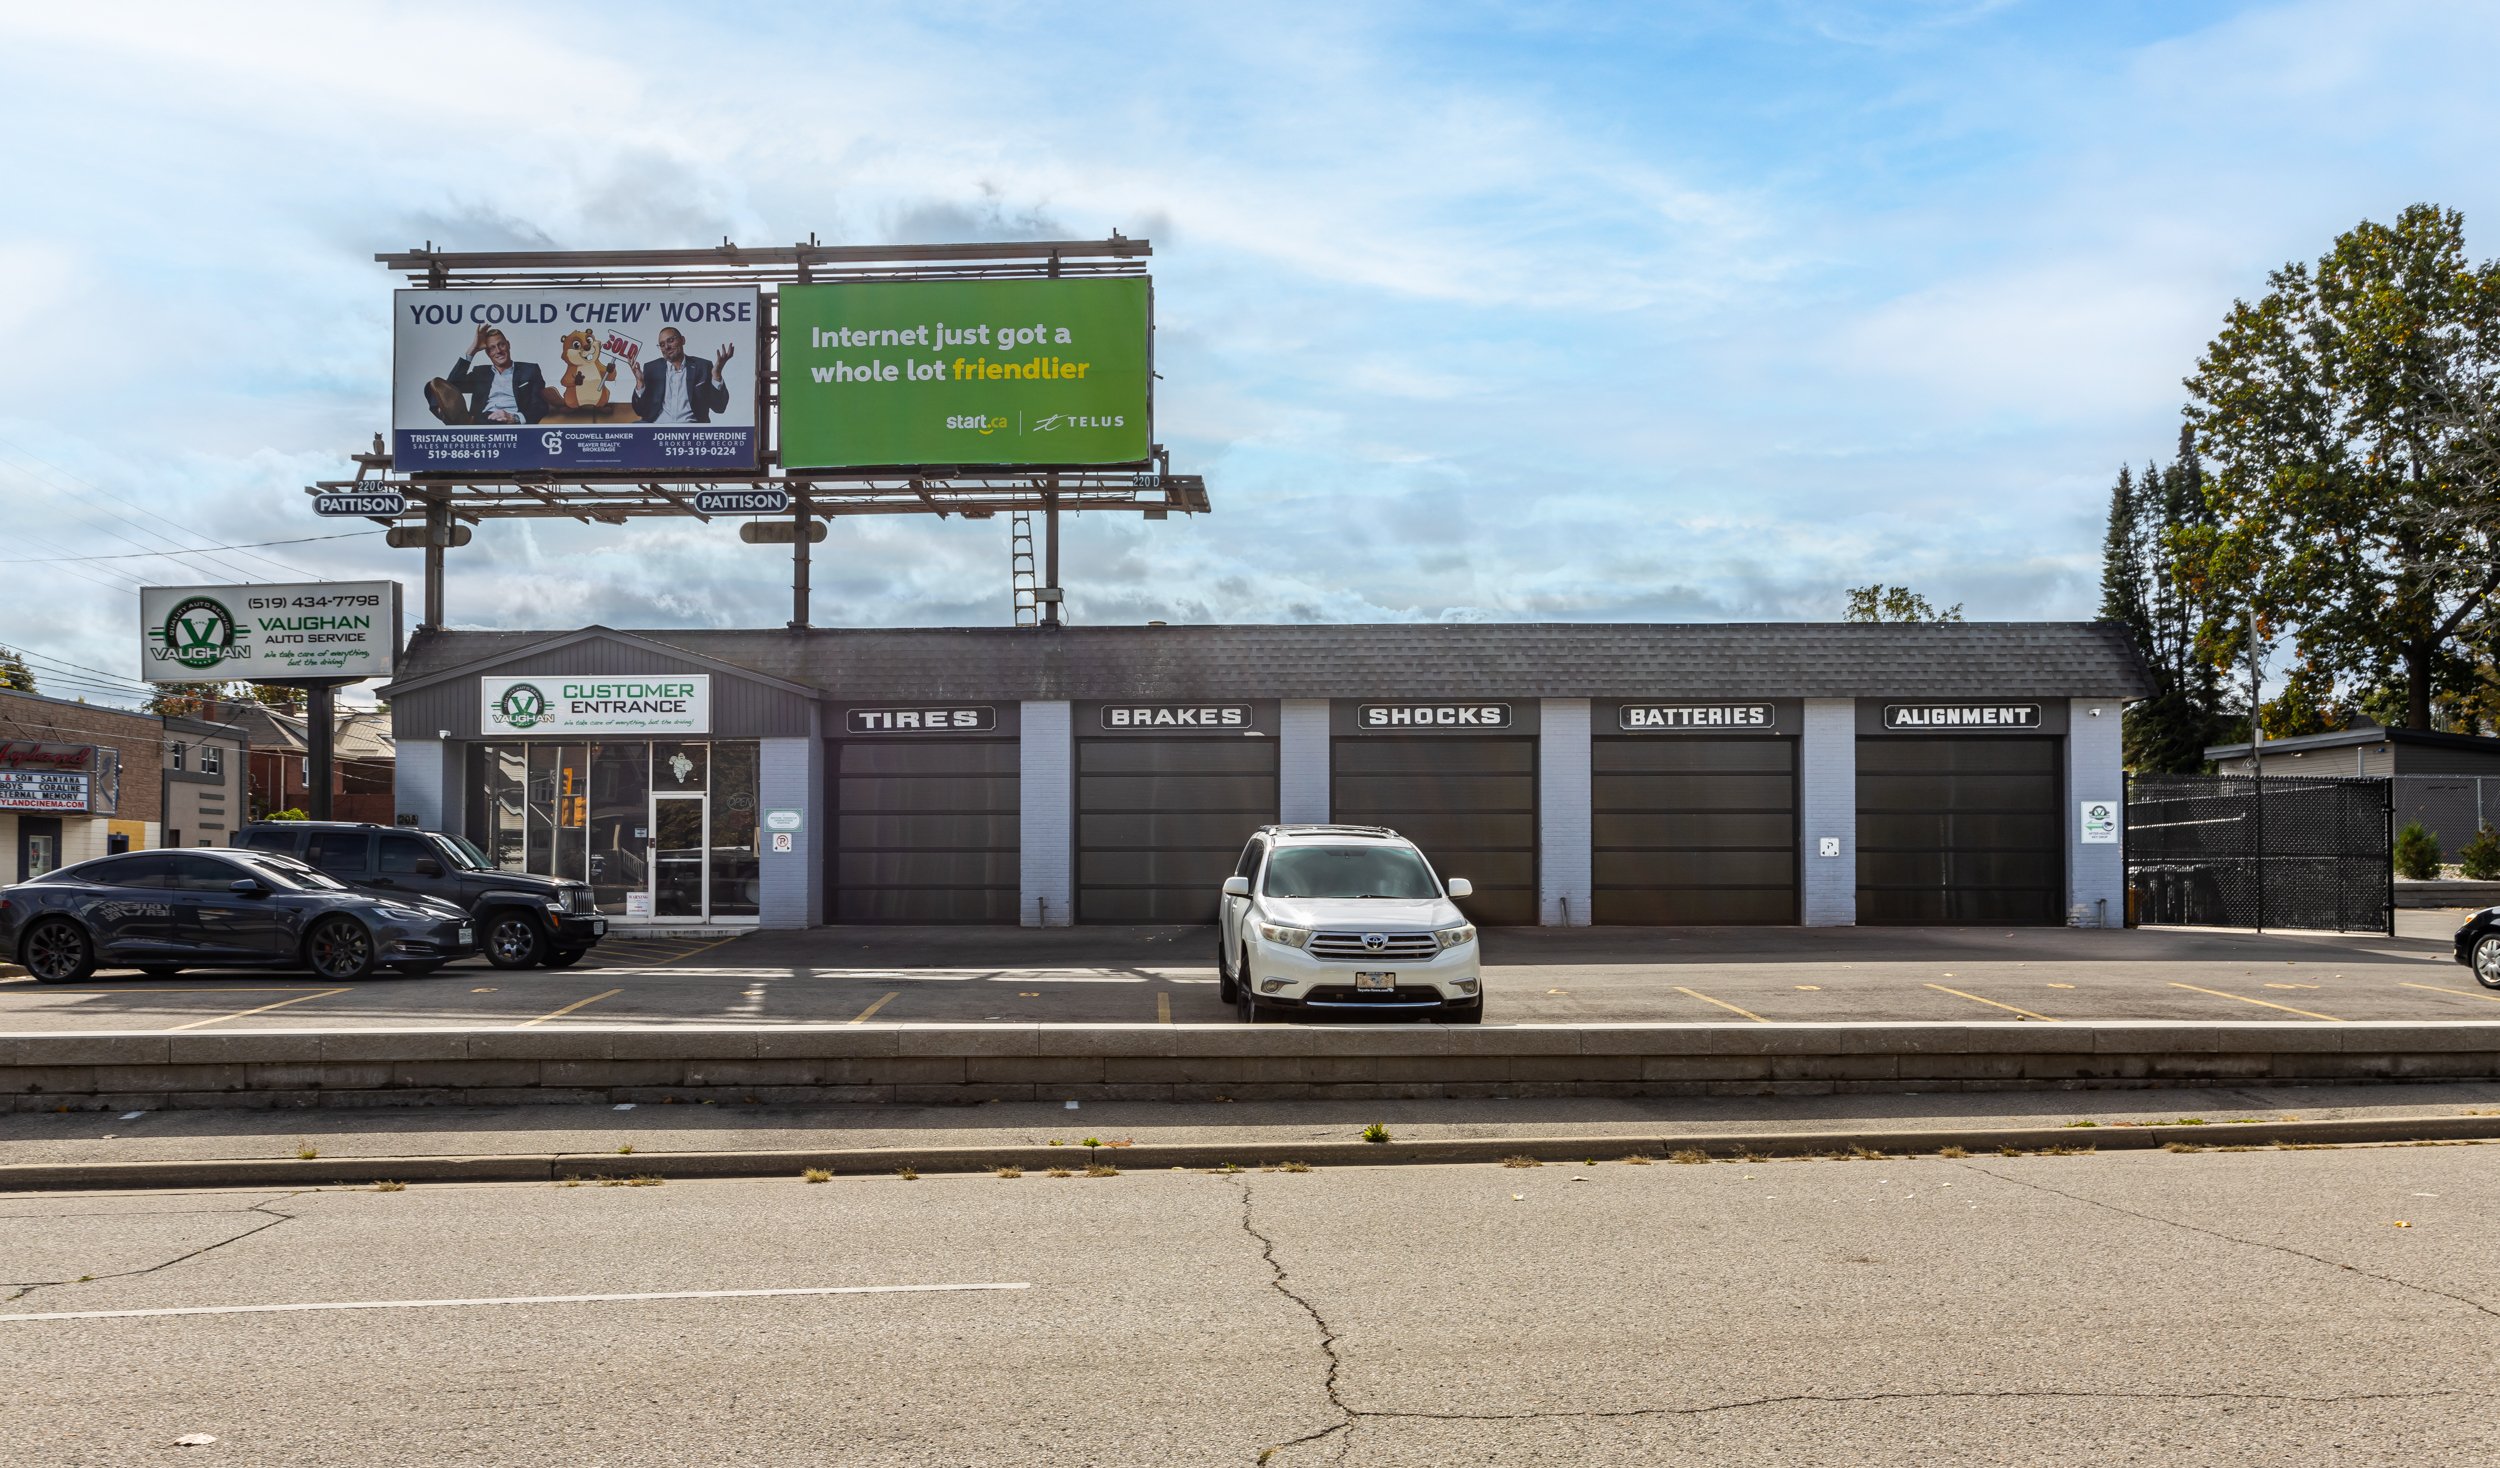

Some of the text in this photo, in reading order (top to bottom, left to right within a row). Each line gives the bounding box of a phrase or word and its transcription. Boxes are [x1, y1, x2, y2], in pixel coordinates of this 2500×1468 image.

[409, 301, 752, 325] YOU COULD 'CHEW' WORSE
[811, 323, 1072, 351] Internet just got a
[603, 334, 639, 360] SOLD
[811, 355, 1090, 383] whole lot friendlier
[946, 414, 1008, 429] start.ca
[1067, 415, 1125, 427] TELUS
[410, 433, 518, 443] TRISTAN SQUIRE-SMITH
[652, 432, 747, 441] JOHNNY HEWERDINE
[427, 449, 500, 459] 519-868-6119
[665, 446, 736, 456] 519-319-0224
[358, 480, 384, 491] 220 C
[1132, 475, 1150, 488] 220
[319, 498, 399, 512] PATTISON
[702, 494, 781, 509] PATTISON
[248, 595, 380, 610] (519) 434-7798
[257, 615, 370, 631] VAUGHAN
[265, 632, 366, 644] AUTO SERVICE
[150, 645, 251, 661] VAUGHAN
[279, 650, 295, 658] take
[317, 649, 330, 657] of
[287, 659, 302, 667] but
[304, 658, 318, 666] the
[563, 683, 695, 699] CUSTOMER
[571, 700, 687, 714] ENTRANCE
[492, 713, 555, 723] VAUGHAN
[859, 710, 978, 729] TIRES
[1111, 708, 1242, 726] BRAKES
[1368, 707, 1502, 725] SHOCKS
[1630, 707, 1765, 726] BATTERIES
[1895, 707, 2032, 725] ALIGNMENT
[15, 774, 33, 782] SON
[40, 775, 80, 784] SANTANA
[0, 782, 81, 791] BOYS CORALINE
